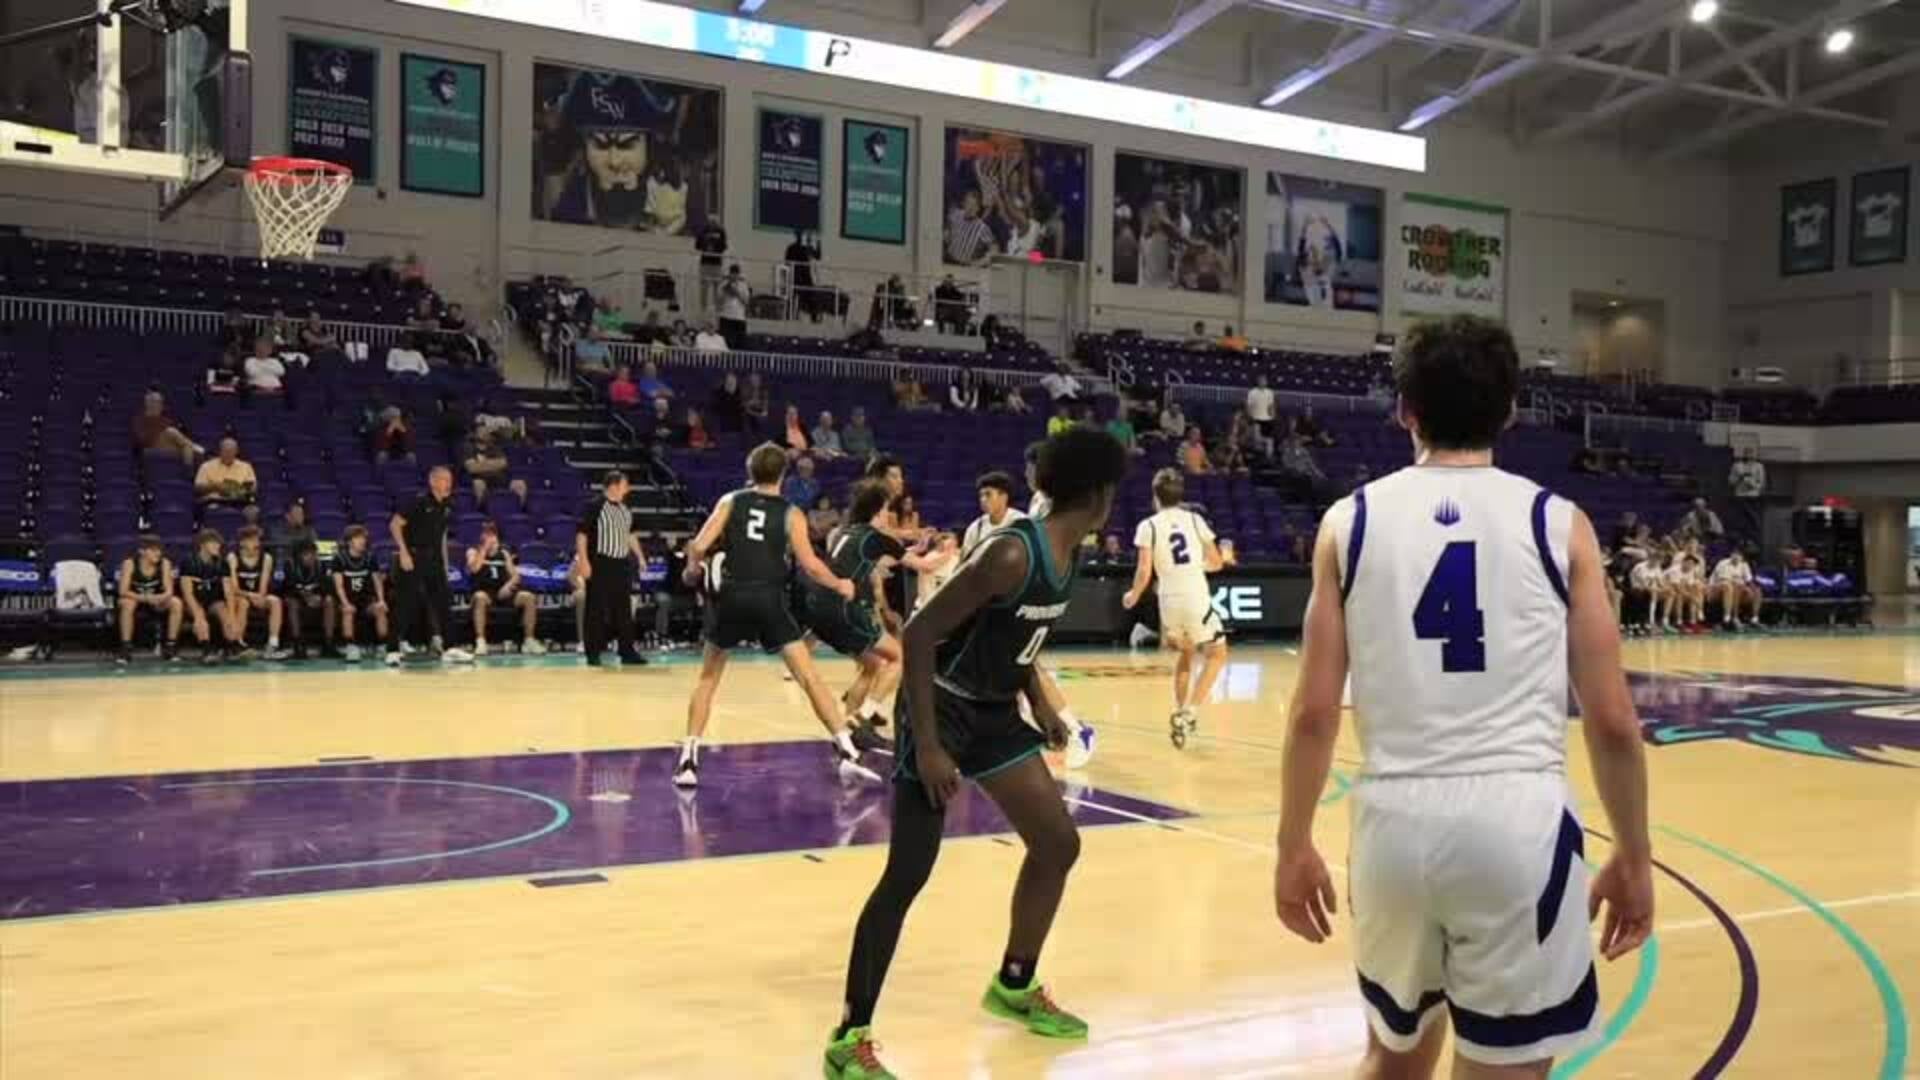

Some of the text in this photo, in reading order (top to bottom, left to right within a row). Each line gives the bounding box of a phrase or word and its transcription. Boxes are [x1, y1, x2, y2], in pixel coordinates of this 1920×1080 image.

[591, 87, 625, 120] FSW
[746, 508, 767, 542] 2
[1168, 532, 1191, 565] 2
[1412, 540, 1486, 673] 4
[1015, 625, 1049, 665] 0
